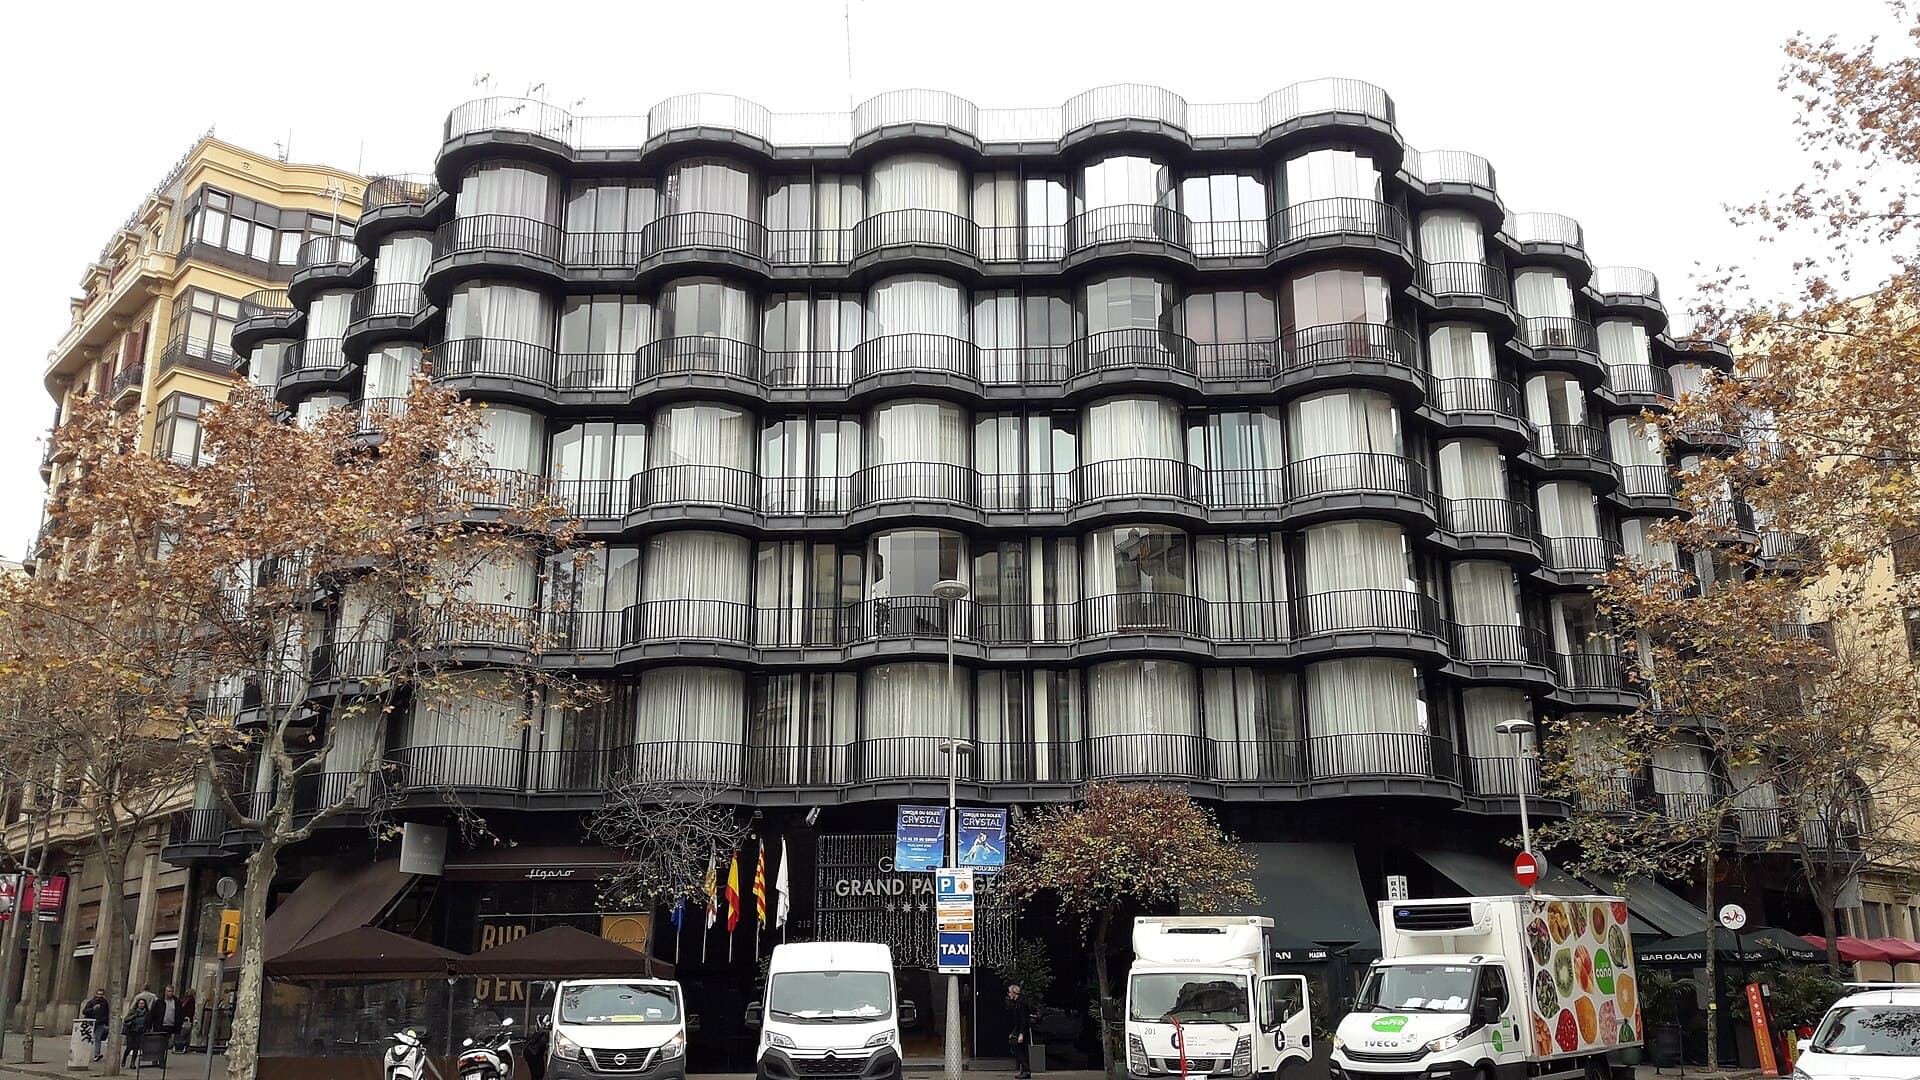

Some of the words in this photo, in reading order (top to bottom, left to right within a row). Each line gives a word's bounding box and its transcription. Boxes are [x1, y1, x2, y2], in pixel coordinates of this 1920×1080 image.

[902, 815, 941, 824] CRYSTAL
[962, 818, 1002, 827] CRYSTAL
[525, 869, 575, 880] figaro
[835, 878, 904, 896] GRAND
[941, 878, 951, 892] P
[940, 944, 969, 955] TAXI
[1641, 953, 1664, 961] BAR
[1664, 952, 1702, 961] GALAN
[1144, 1027, 1157, 1035] 201
[1364, 1040, 1399, 1048] IVECO
